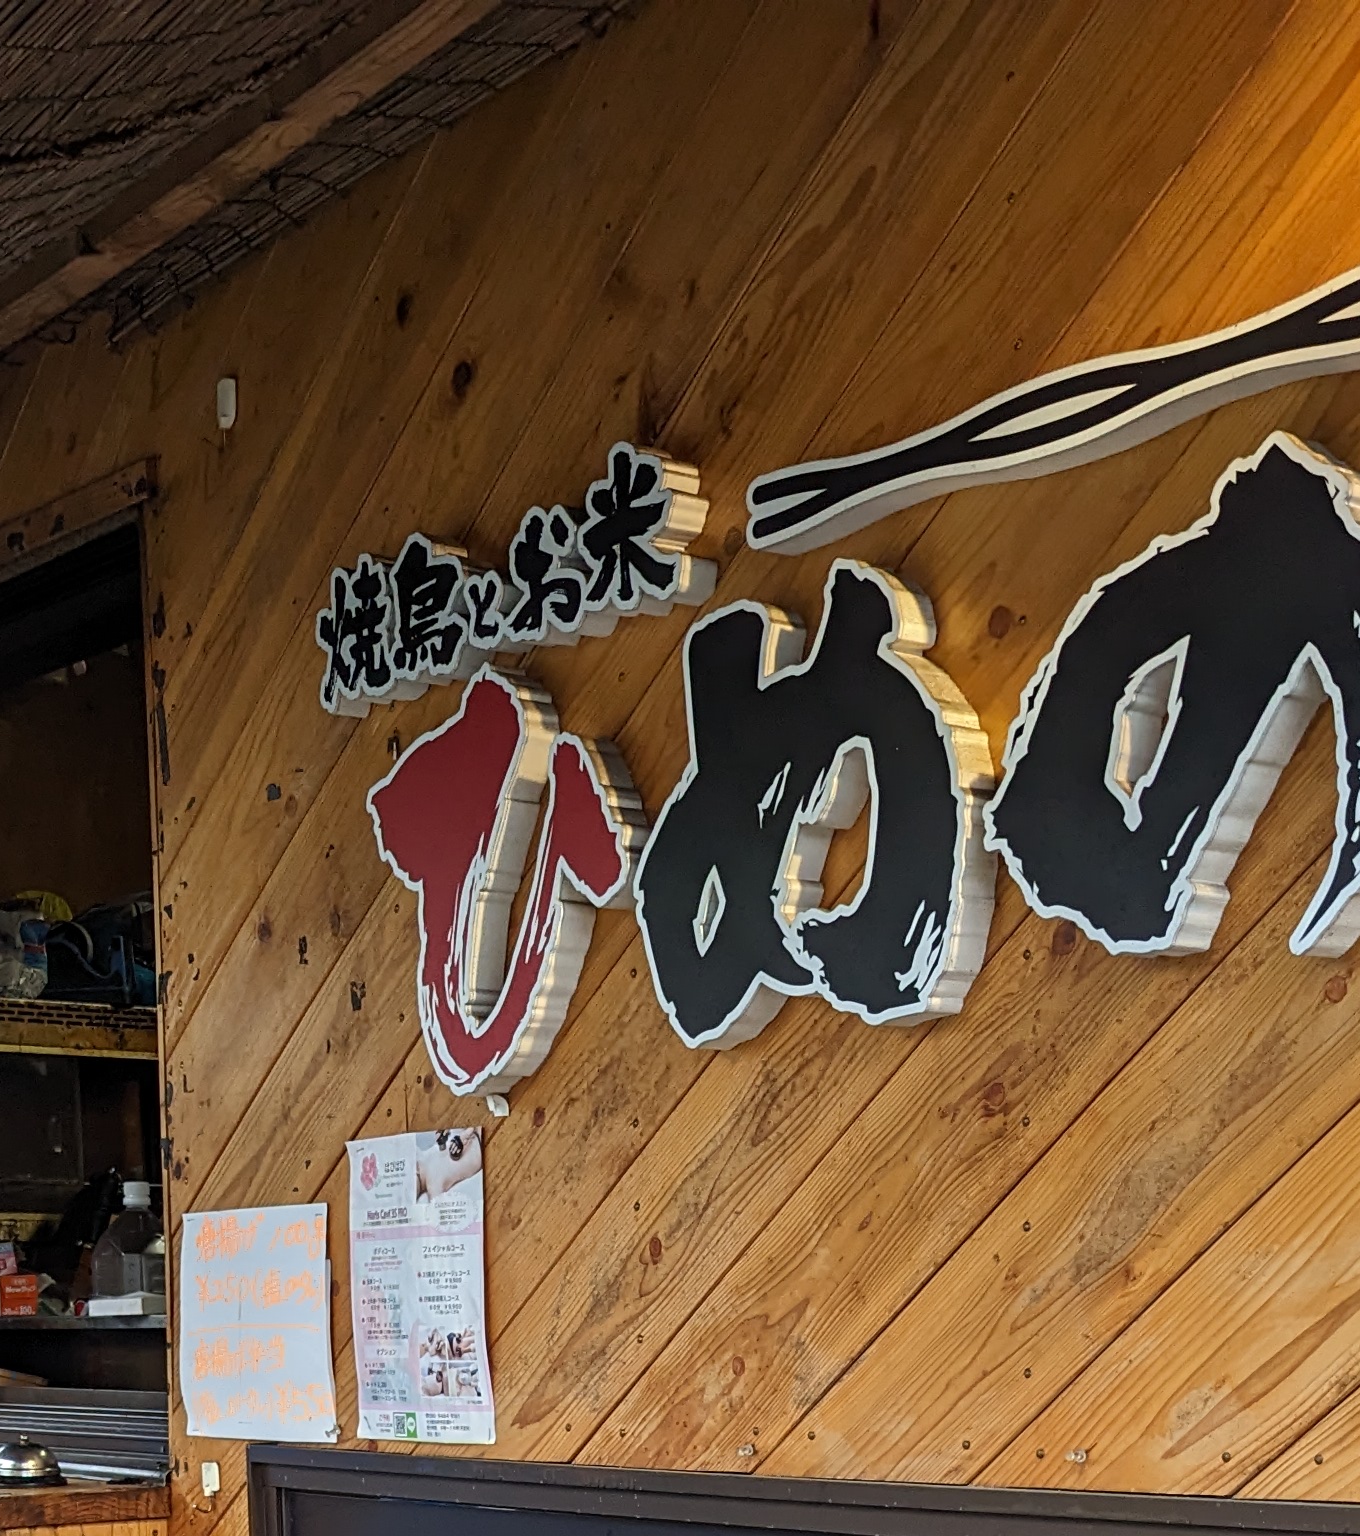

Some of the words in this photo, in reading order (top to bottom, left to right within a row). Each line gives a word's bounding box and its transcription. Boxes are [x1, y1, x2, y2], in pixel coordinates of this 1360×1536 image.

[319, 442, 679, 707] 焼鳥とお米
